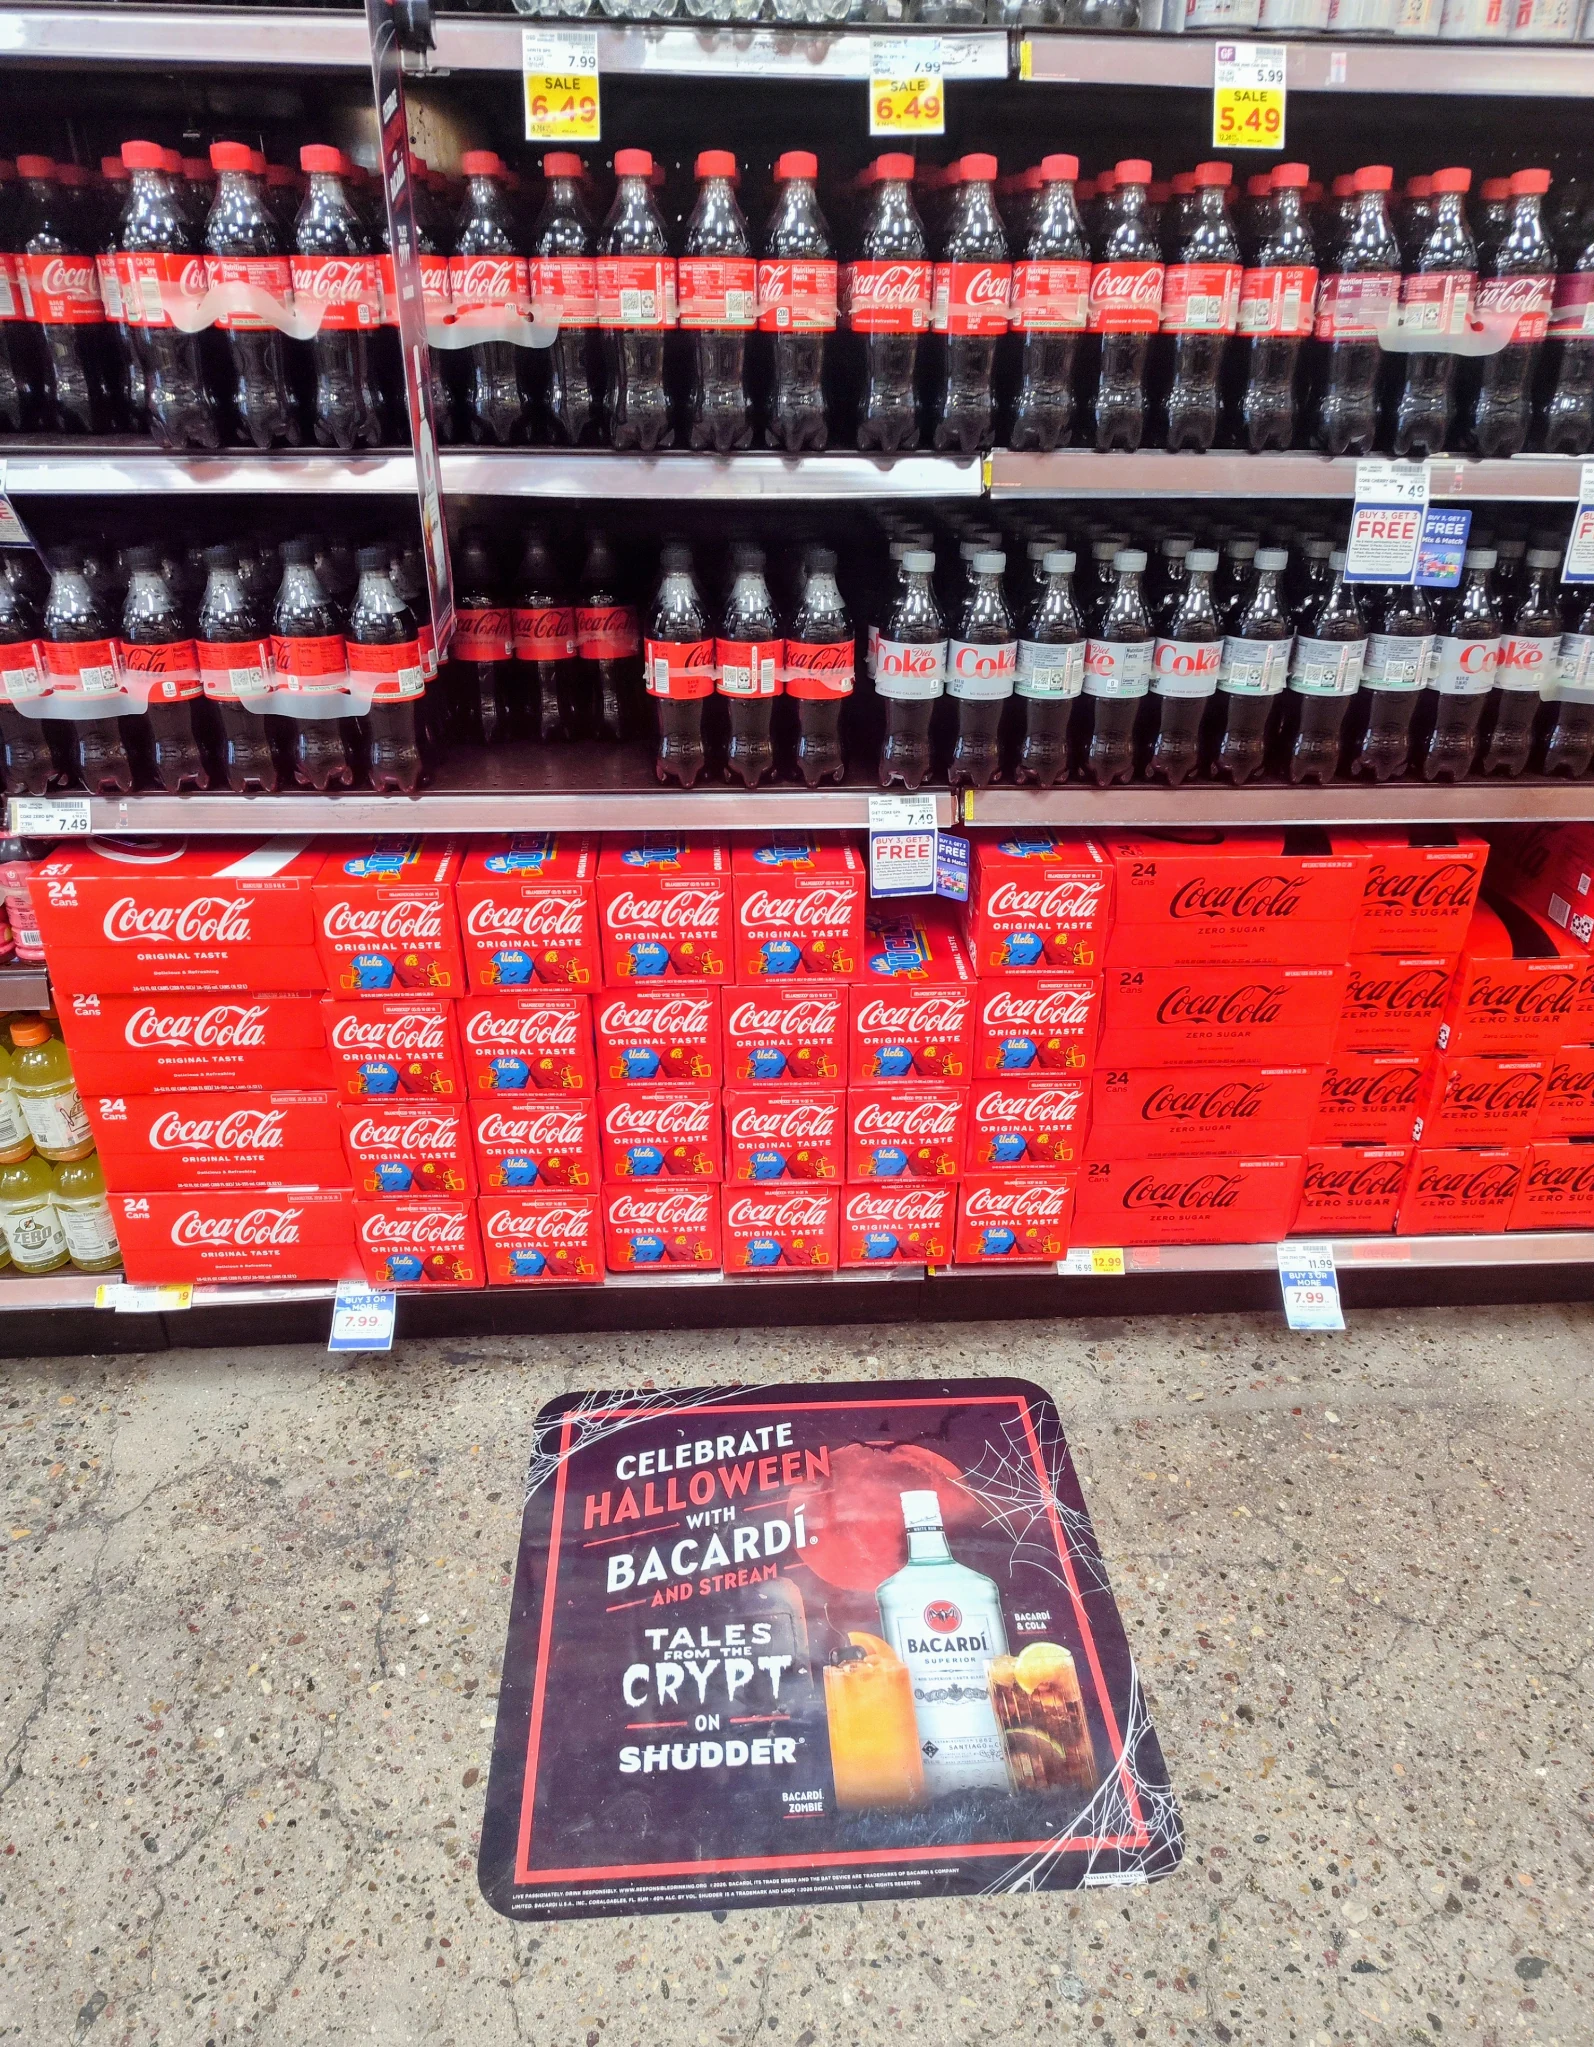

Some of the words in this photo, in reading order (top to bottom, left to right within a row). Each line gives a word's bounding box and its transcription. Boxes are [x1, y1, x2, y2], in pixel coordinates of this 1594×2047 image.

[1220, 48, 1233, 60] GF
[568, 56, 596, 68] 7.99
[1257, 69, 1284, 82] 5.99
[544, 77, 581, 90] SALE
[890, 80, 926, 92] SALE
[1233, 90, 1268, 102] SALE
[531, 95, 597, 122] 6.49
[876, 96, 940, 119] 6.49
[1220, 107, 1280, 132] 5.49
[1485, 280, 1508, 289] Cherry
[1358, 511, 1378, 519] BUY
[1356, 521, 1416, 539] FREE
[1425, 522, 1465, 535] FREE
[1441, 537, 1463, 545] Match
[1090, 643, 1109, 654] Diet
[1518, 640, 1540, 649] Diet
[911, 647, 933, 658] Diet
[59, 819, 88, 830] 7.49
[907, 813, 933, 825] 7.49
[876, 837, 894, 845] BUY
[876, 844, 930, 860] FREE
[938, 844, 966, 859] FREE
[1131, 862, 1157, 877] 24
[1130, 878, 1155, 886] Cans
[47, 881, 77, 898] 24
[50, 898, 79, 907] Cans
[987, 881, 1105, 918] Coca-Cola
[1169, 875, 1315, 919] Coca-Cola
[606, 890, 725, 928] Coca-Cola
[740, 889, 858, 928] Coca-Cola
[1363, 908, 1404, 917] ZERO
[1409, 907, 1460, 917] SUGAR
[103, 897, 255, 942] Coca-Cola
[323, 900, 444, 939] Coca-Cola
[467, 898, 587, 936] Coca-Cola
[992, 921, 1051, 930] ORIGINAL
[1056, 921, 1093, 930] TASTE
[1197, 926, 1226, 935] ZERO
[1229, 925, 1266, 934] SUGAR
[614, 932, 675, 941] ORIGINAL
[680, 930, 718, 939] TASTE
[747, 930, 807, 939] ORIGINAL
[811, 929, 849, 938] TASTE
[334, 942, 398, 951] ORIGINAL
[401, 941, 441, 950] TASTE
[137, 952, 191, 961] ORIGINAL
[193, 951, 229, 960] TASTE
[953, 952, 968, 980] ORIGINAL
[72, 994, 101, 1007] 24
[1156, 984, 1292, 1024] Coca-Cola
[74, 1008, 101, 1017] Cans
[857, 998, 971, 1034] Coca-Cola
[124, 1005, 270, 1048] Coca-Cola
[863, 1036, 921, 1045] ORIGINAL
[924, 1035, 961, 1043] TASTE
[98, 1098, 127, 1112] 24
[101, 1112, 128, 1120] Cans
[148, 1109, 288, 1150] Coca-Cola
[477, 1112, 587, 1144] Coca-Cola
[181, 1155, 232, 1163] ORIGINAL
[965, 1186, 1070, 1217] Coca-Cola
[170, 1207, 304, 1246] Coca-Cola
[361, 1212, 468, 1243] Coca-Cola
[12, 1226, 52, 1243] ZERO
[370, 1245, 426, 1253] ORIGINAL
[430, 1244, 465, 1252] TASTE
[1093, 1257, 1122, 1267] 12.99
[1308, 1259, 1333, 1269] 11.99
[345, 1296, 365, 1304] BUY
[1293, 1291, 1324, 1303] 7.99
[352, 1303, 379, 1311] MORE
[345, 1316, 379, 1327] 7.99
[616, 1422, 794, 1481] CELEBRATE
[583, 1445, 831, 1530] HALLOWEEN
[685, 1505, 737, 1530] WITH
[650, 1580, 694, 1608] AND
[698, 1562, 779, 1595] STREAM
[1016, 1621, 1024, 1631] &
[1025, 1621, 1047, 1631] COLA
[644, 1622, 773, 1651] TALES
[663, 1648, 711, 1661] FROM
[720, 1645, 753, 1657] THE
[924, 1656, 977, 1665] SUPERIOR
[622, 1654, 793, 1708] CRYPT
[694, 1714, 721, 1733] ON
[948, 1743, 987, 1751] SANTIAGO
[788, 1801, 824, 1813] ZOMBIE
